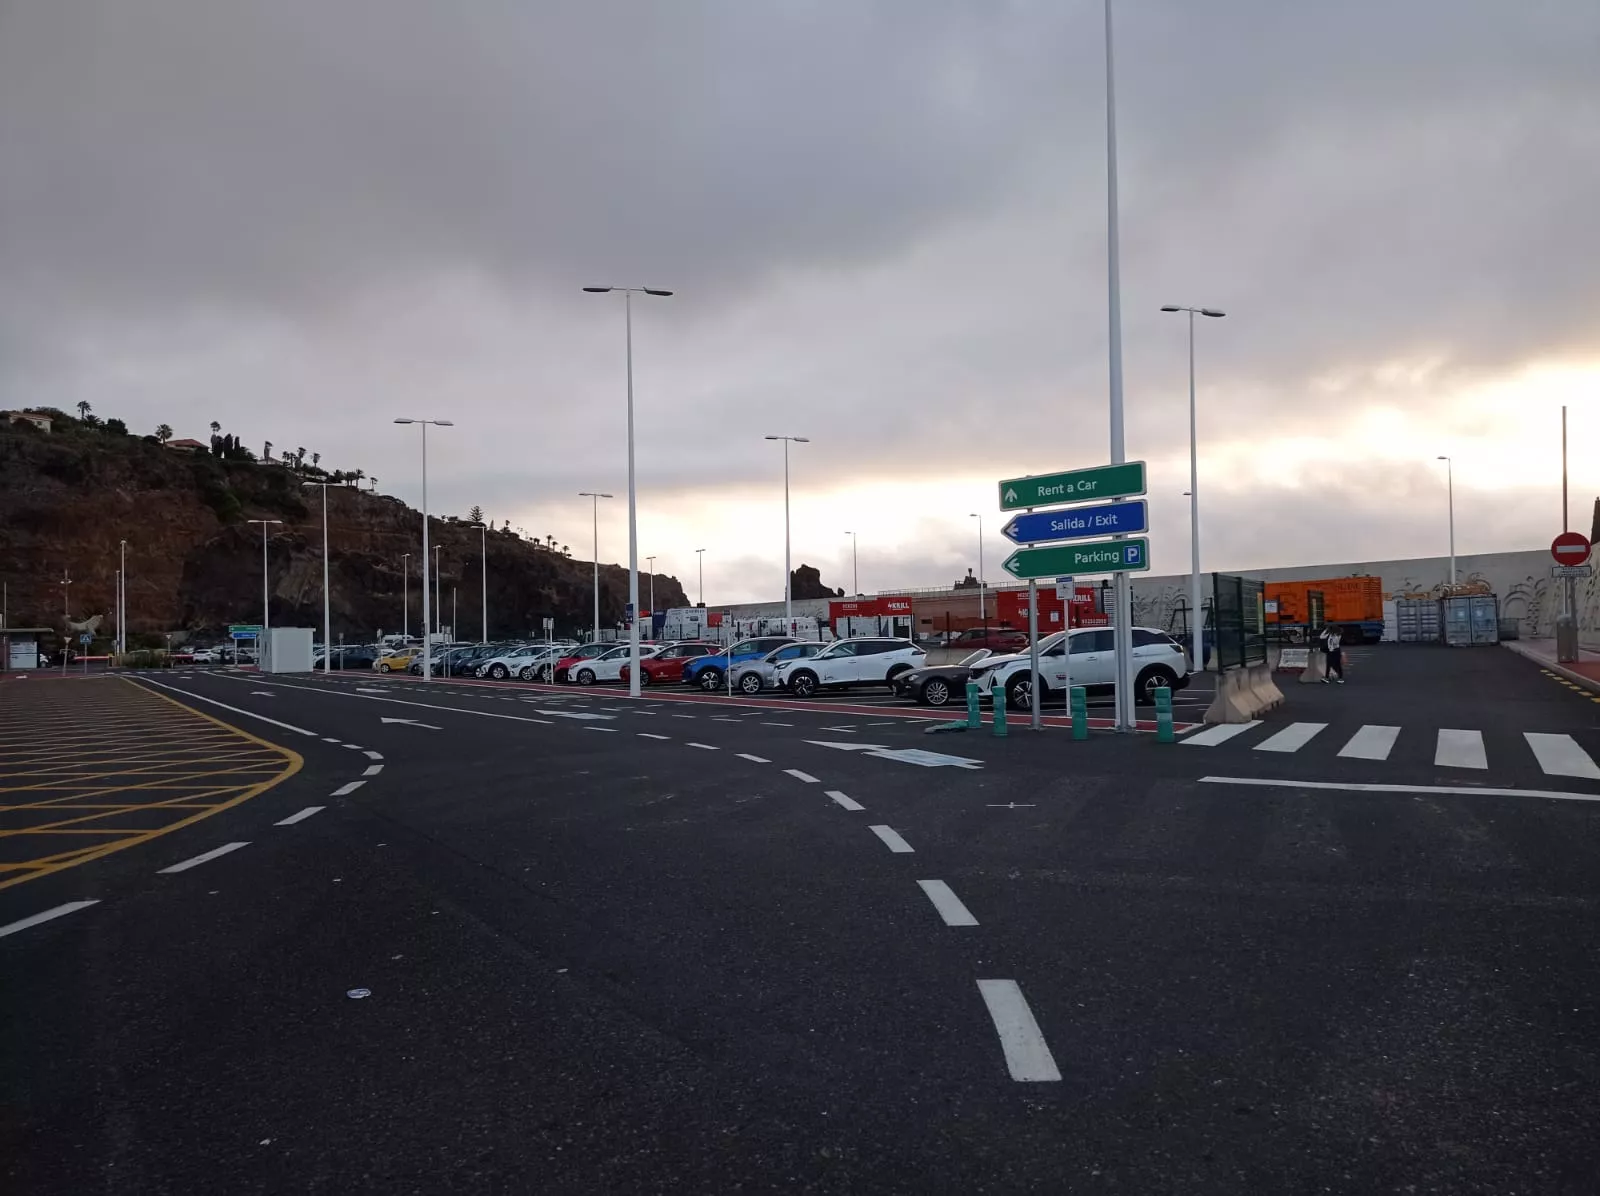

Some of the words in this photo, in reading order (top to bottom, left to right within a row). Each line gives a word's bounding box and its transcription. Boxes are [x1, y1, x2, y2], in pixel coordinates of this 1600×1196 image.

[1037, 483, 1064, 497] Rent
[1067, 484, 1074, 493] a
[1077, 480, 1097, 491] Car
[1051, 517, 1085, 531] Salida
[1087, 516, 1093, 528] /
[1095, 514, 1118, 526] Exit
[1074, 550, 1120, 564] Parking
[1127, 548, 1138, 562] P
